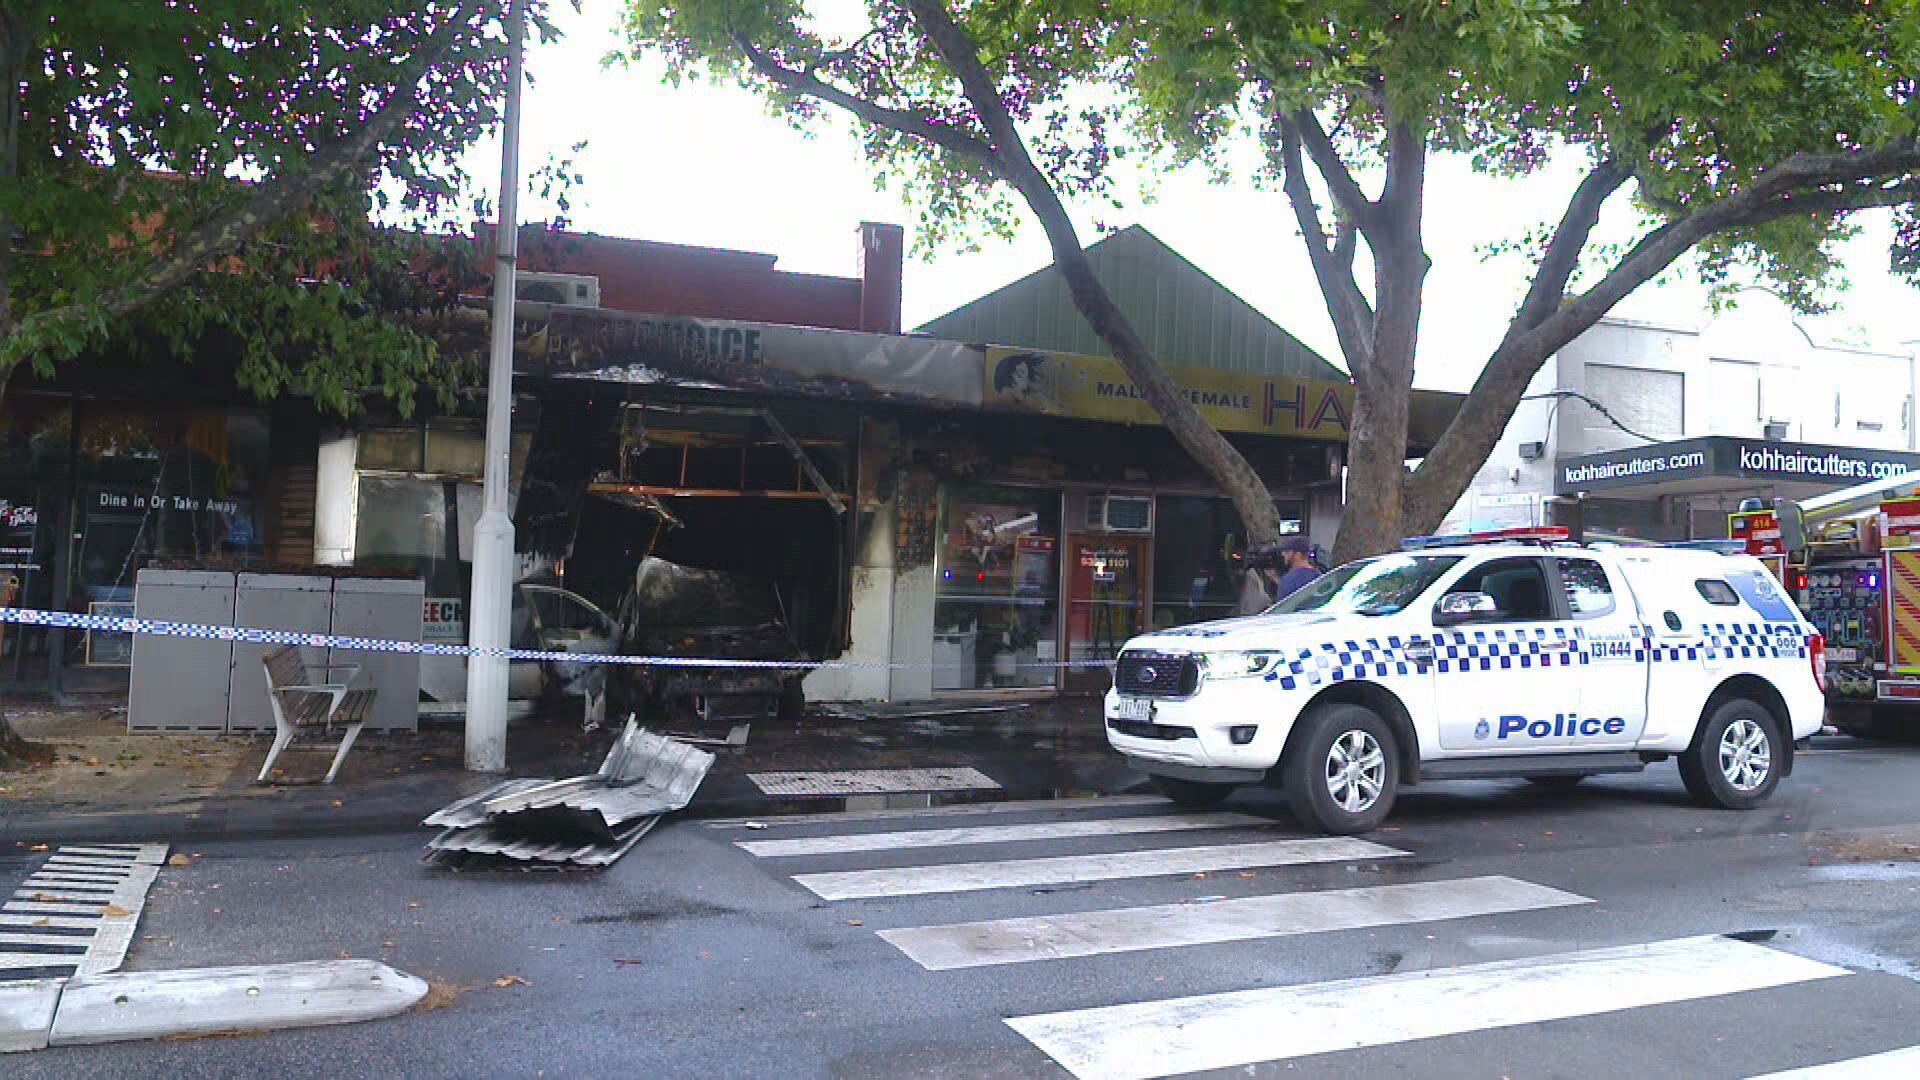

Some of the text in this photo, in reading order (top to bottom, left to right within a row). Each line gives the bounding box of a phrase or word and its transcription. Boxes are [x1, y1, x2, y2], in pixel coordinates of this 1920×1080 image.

[1565, 451, 1704, 483] kohhaircutters.com
[1740, 445, 1907, 478] kohhaircutters.com
[100, 492, 128, 507] Dine
[150, 495, 167, 509] Or
[173, 496, 199, 510] Take
[206, 498, 237, 515] Away
[1497, 713, 1626, 739] Police
